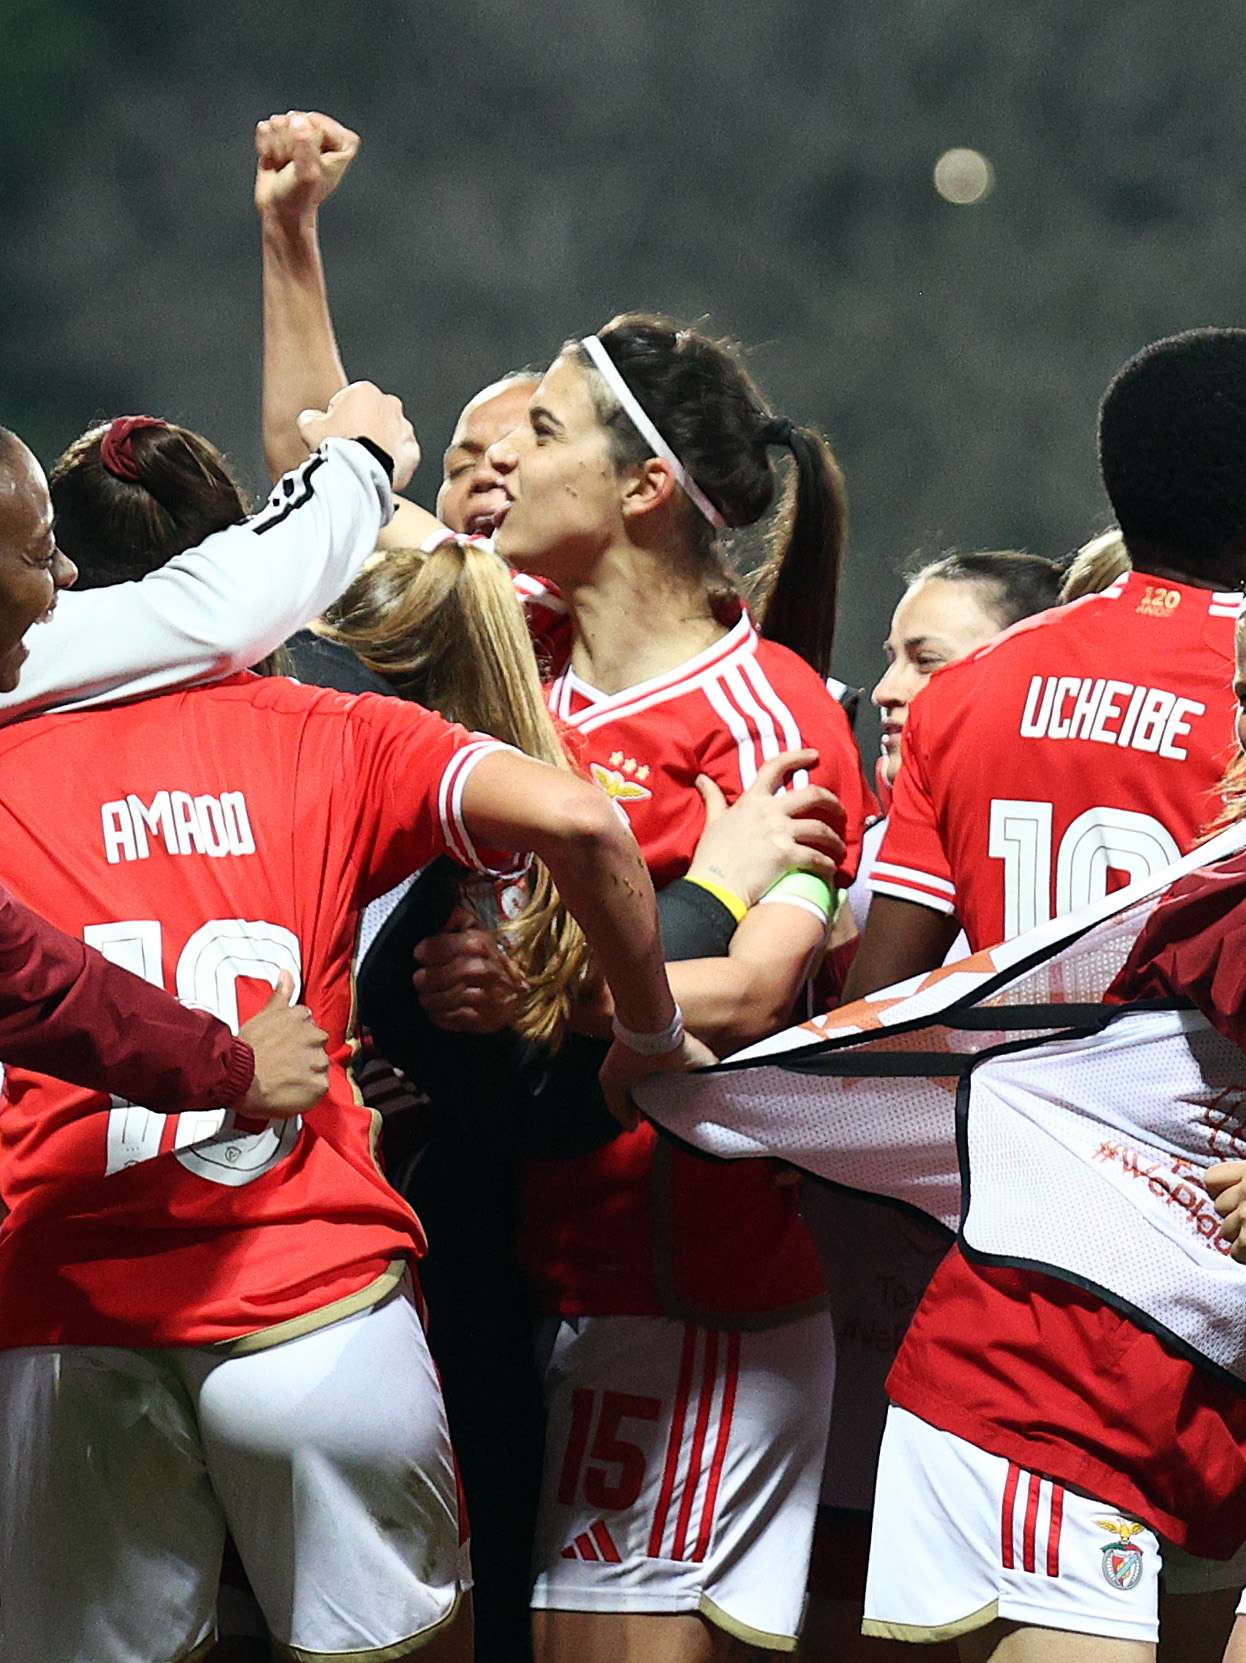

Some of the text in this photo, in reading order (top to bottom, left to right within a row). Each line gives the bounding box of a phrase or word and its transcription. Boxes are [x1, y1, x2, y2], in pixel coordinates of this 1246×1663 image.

[1141, 586, 1181, 609] 120
[1019, 676, 1205, 761] UCHEIBE
[101, 790, 256, 864] AMADO
[556, 1386, 662, 1512] 15
